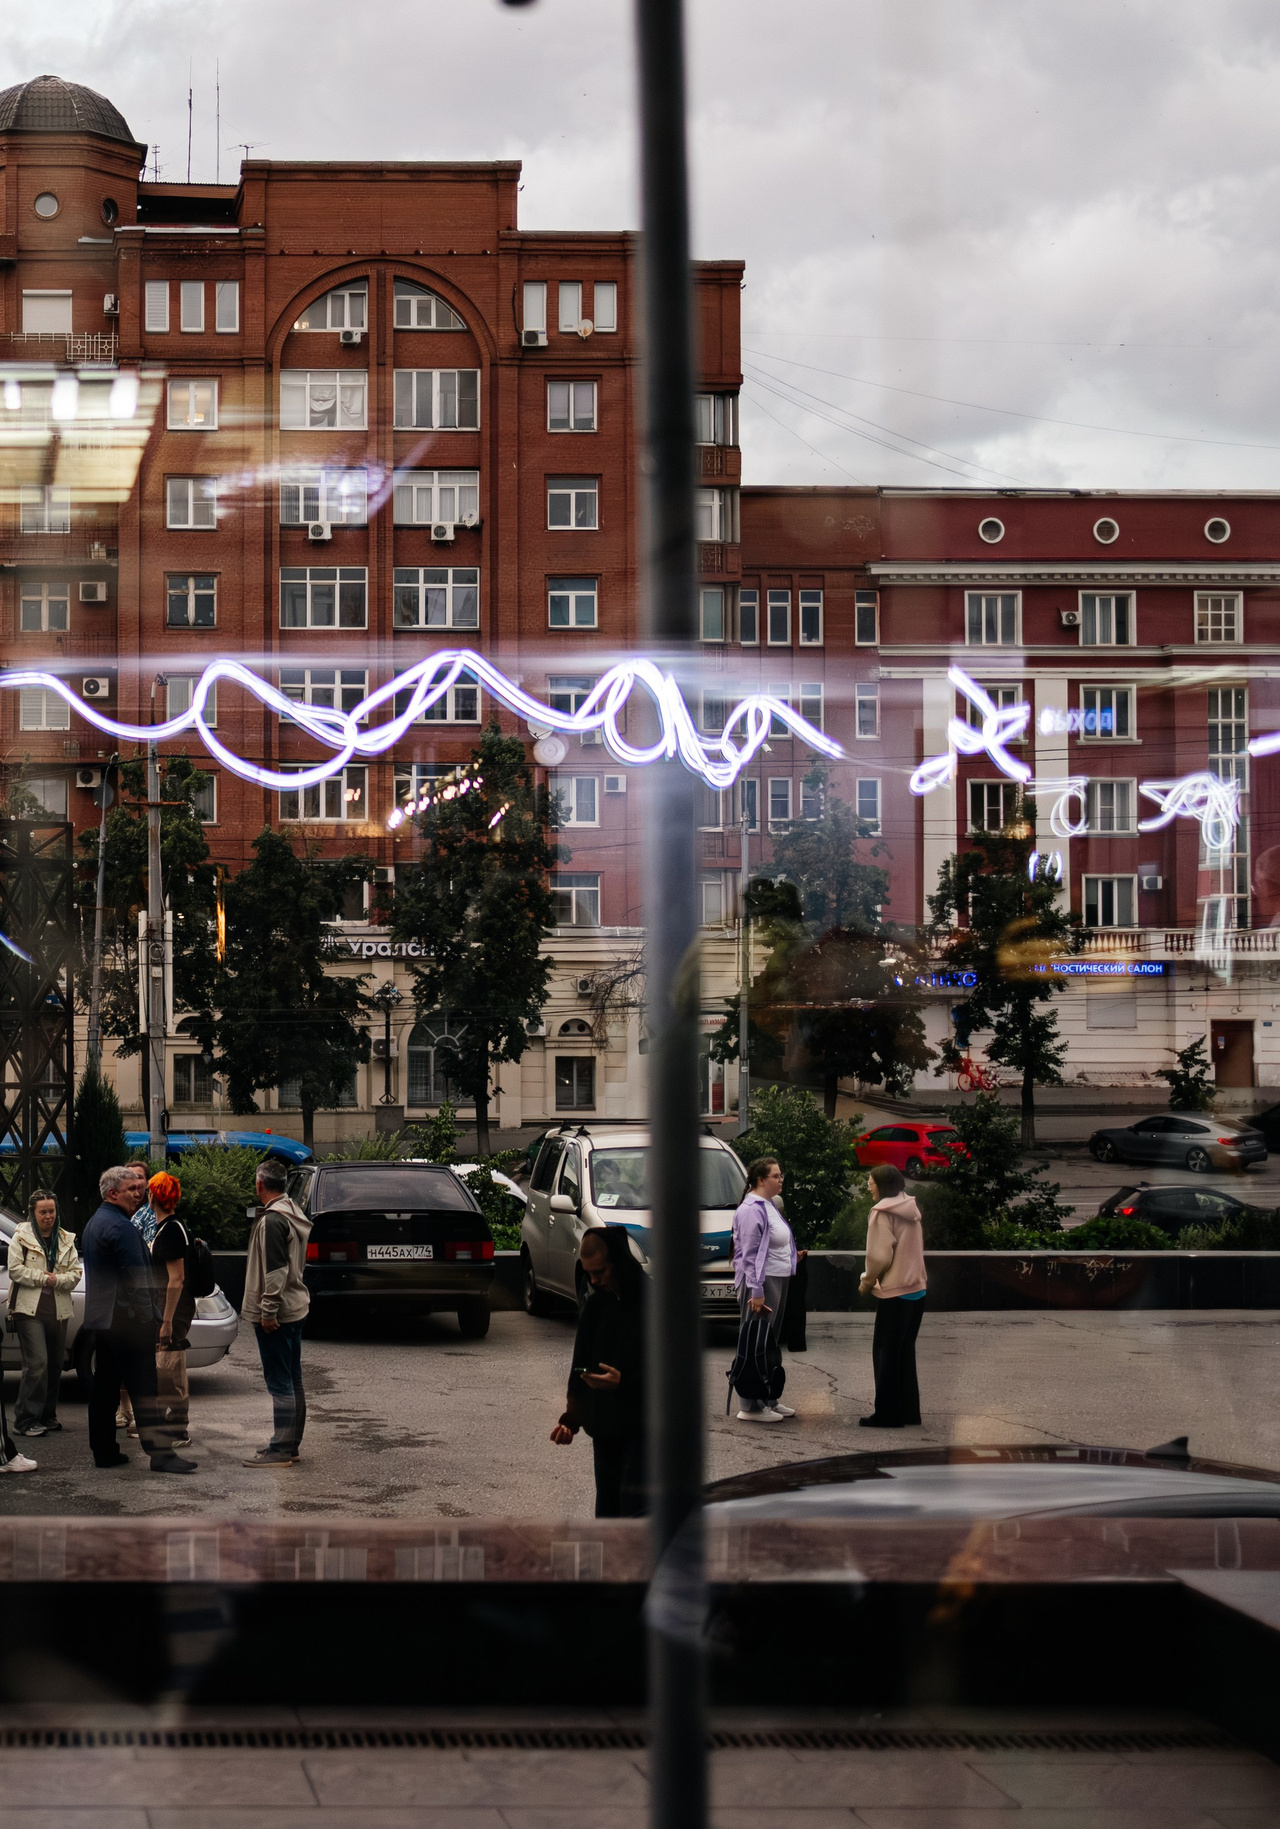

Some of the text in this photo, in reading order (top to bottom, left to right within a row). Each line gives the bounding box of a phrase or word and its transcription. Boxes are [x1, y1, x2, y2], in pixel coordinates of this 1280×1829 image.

[1026, 962, 1163, 974] НОСТИЧЕСКИЙ САЛОН
[370, 1245, 432, 1258] Н445АХ 774
[701, 1286, 723, 1297] 2ХТ
